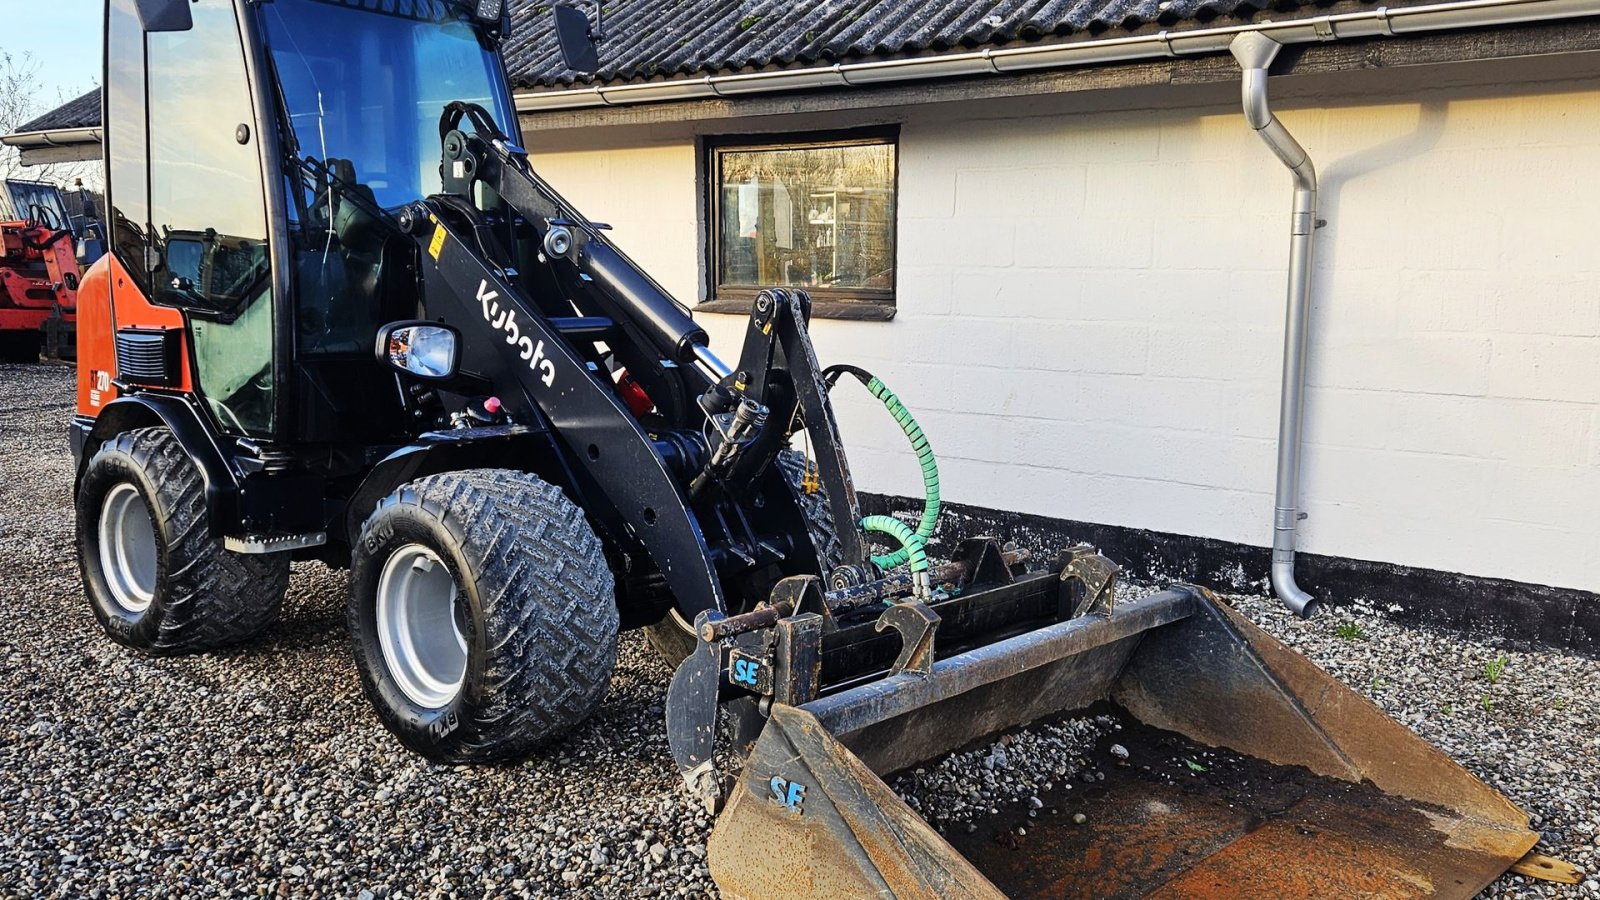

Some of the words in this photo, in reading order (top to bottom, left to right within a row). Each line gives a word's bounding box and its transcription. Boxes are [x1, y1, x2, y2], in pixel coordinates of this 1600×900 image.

[476, 278, 556, 388] Kubota
[734, 659, 760, 685] SE
[769, 775, 807, 816] SE
